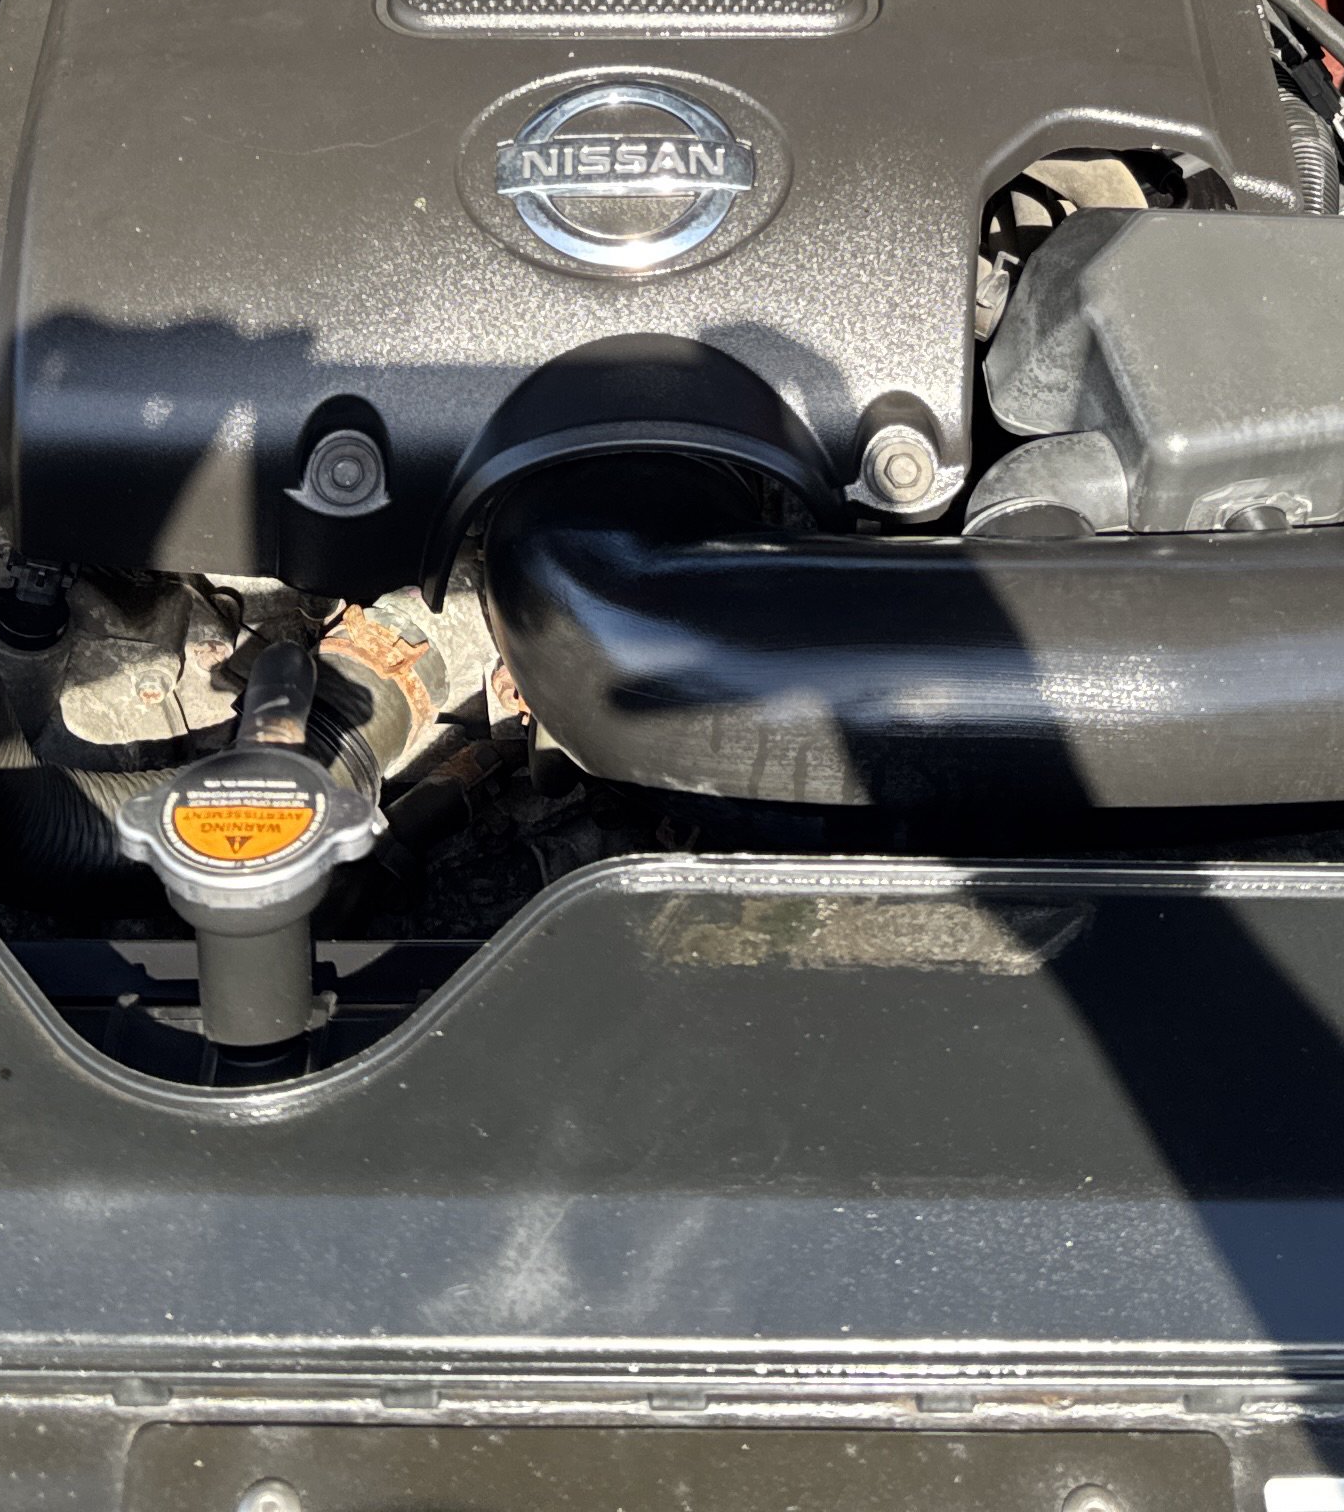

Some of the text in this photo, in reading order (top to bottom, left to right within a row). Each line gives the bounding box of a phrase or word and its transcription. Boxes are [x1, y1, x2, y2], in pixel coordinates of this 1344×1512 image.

[522, 144, 726, 179] NISSAN
[182, 810, 303, 821] AVERTISSEMENT
[200, 822, 281, 833] WARNING
